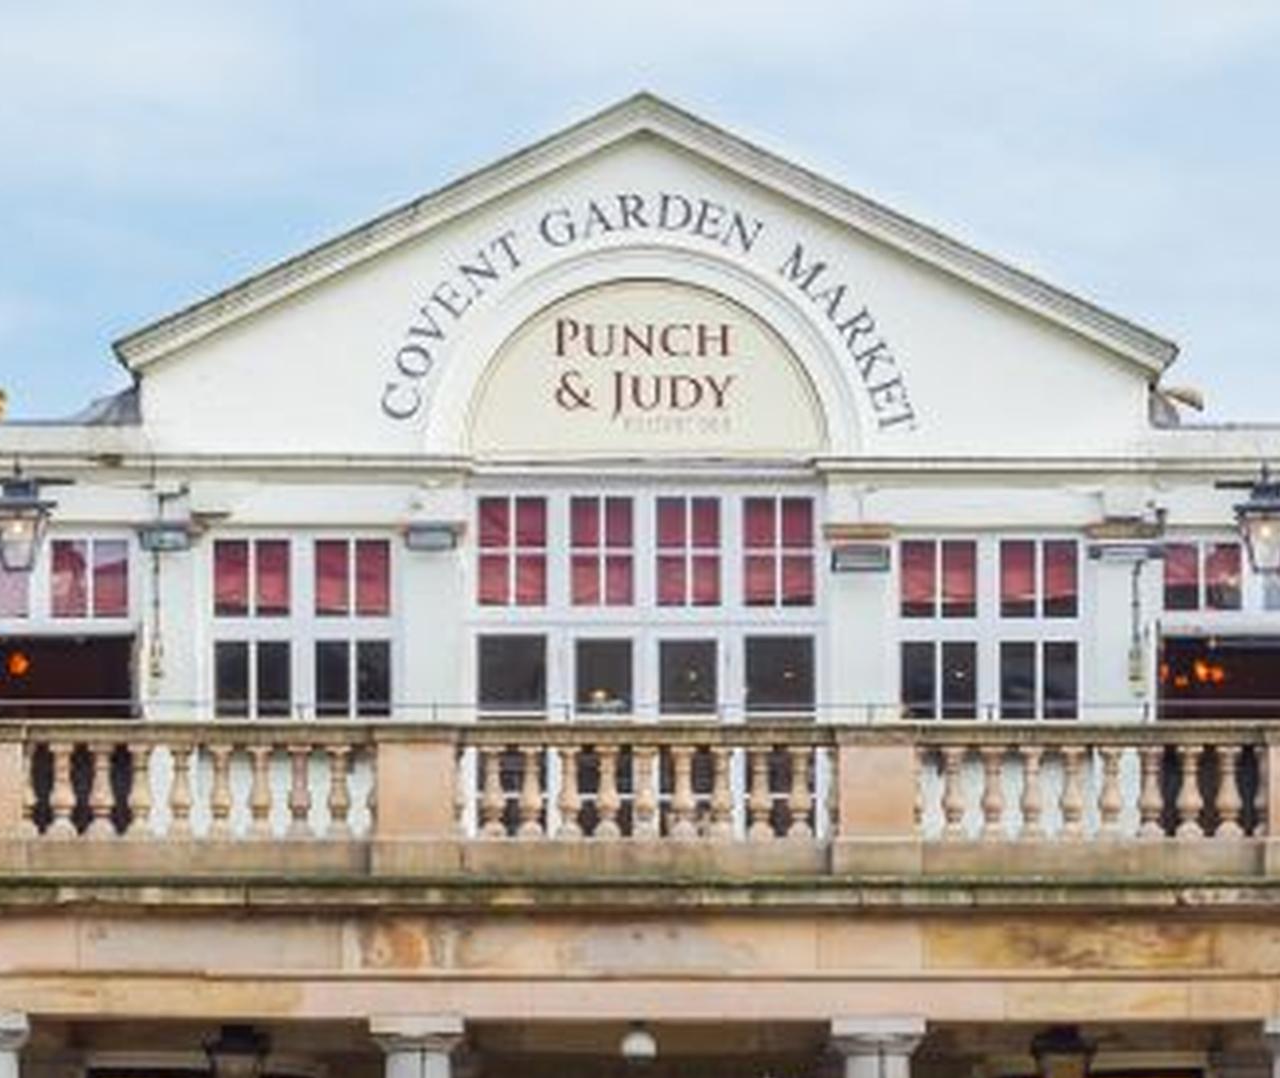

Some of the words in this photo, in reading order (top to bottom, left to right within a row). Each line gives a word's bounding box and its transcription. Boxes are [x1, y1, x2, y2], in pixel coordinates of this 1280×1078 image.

[381, 230, 522, 421] COVENT
[540, 193, 764, 252] GARDEN
[778, 242, 918, 432] MARKET
[555, 318, 731, 357] PUNCH
[555, 370, 598, 411] &
[612, 370, 736, 423] JUDY
